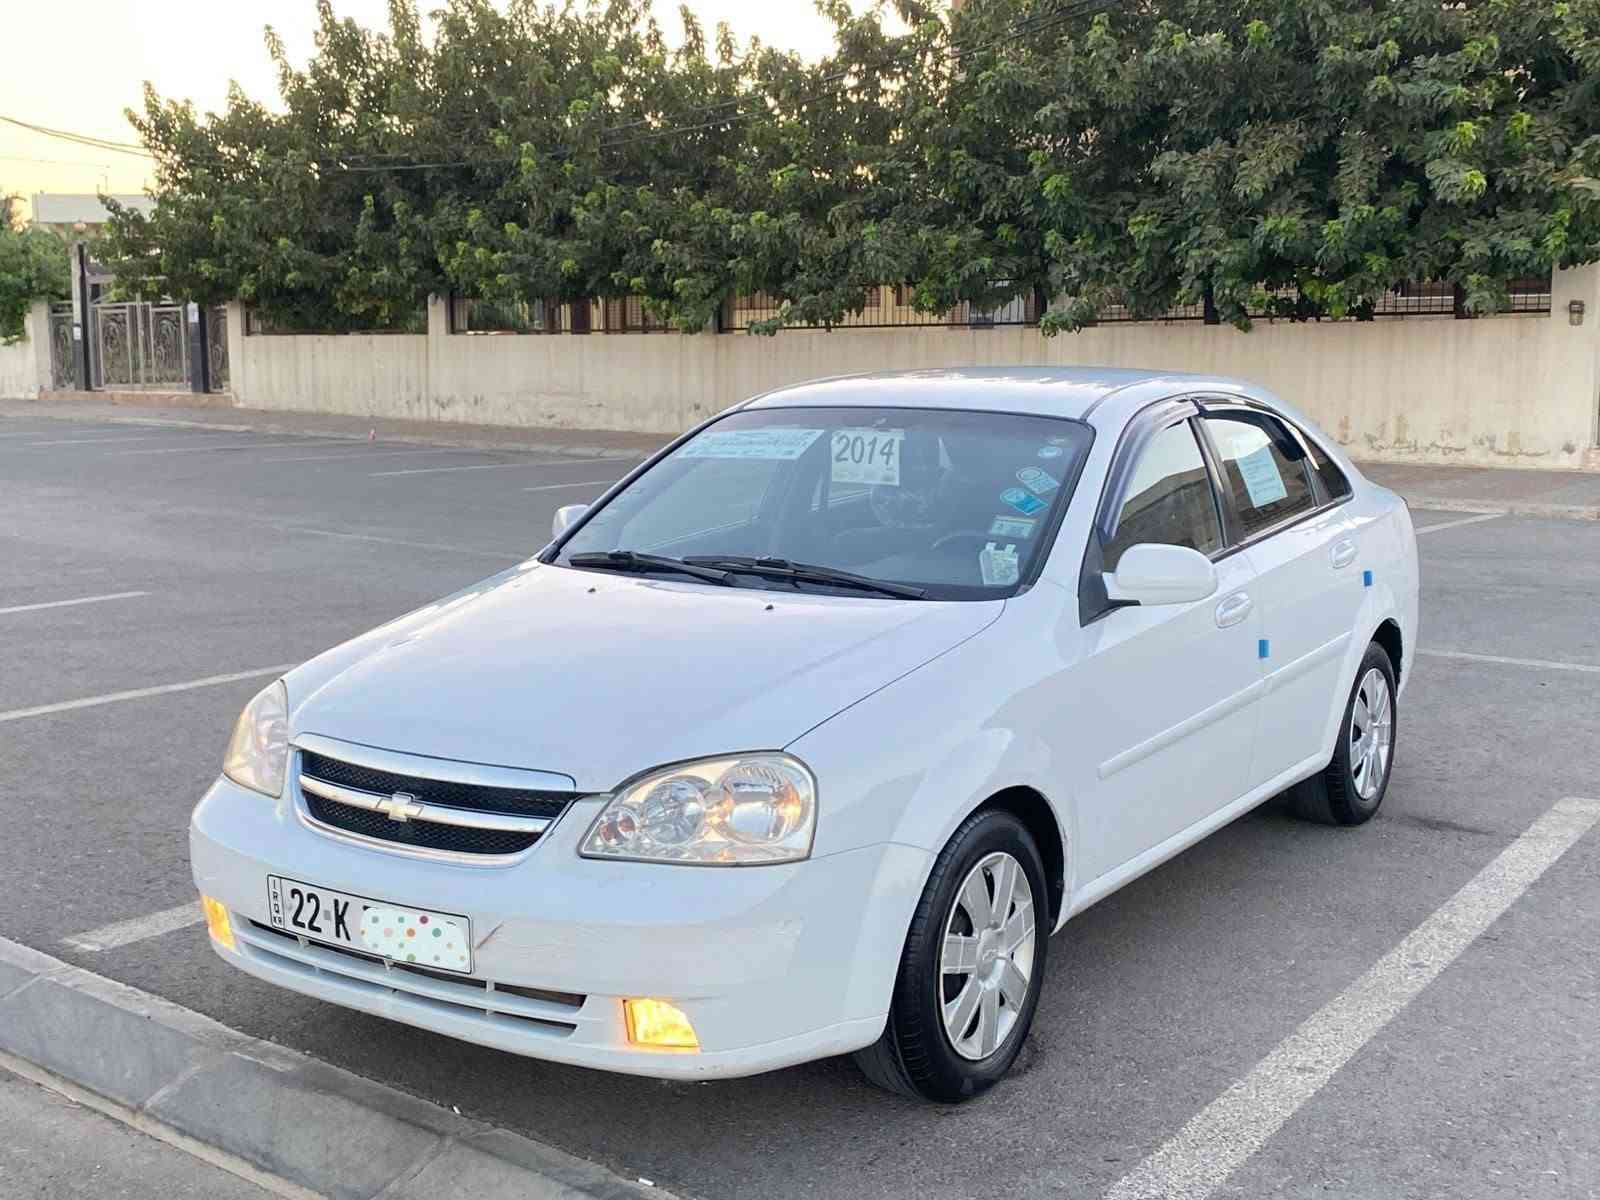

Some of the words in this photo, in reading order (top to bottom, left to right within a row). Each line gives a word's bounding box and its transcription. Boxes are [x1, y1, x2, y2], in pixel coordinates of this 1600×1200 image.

[835, 434, 896, 466] 2014
[290, 888, 322, 933] 22
[334, 898, 351, 941] K
